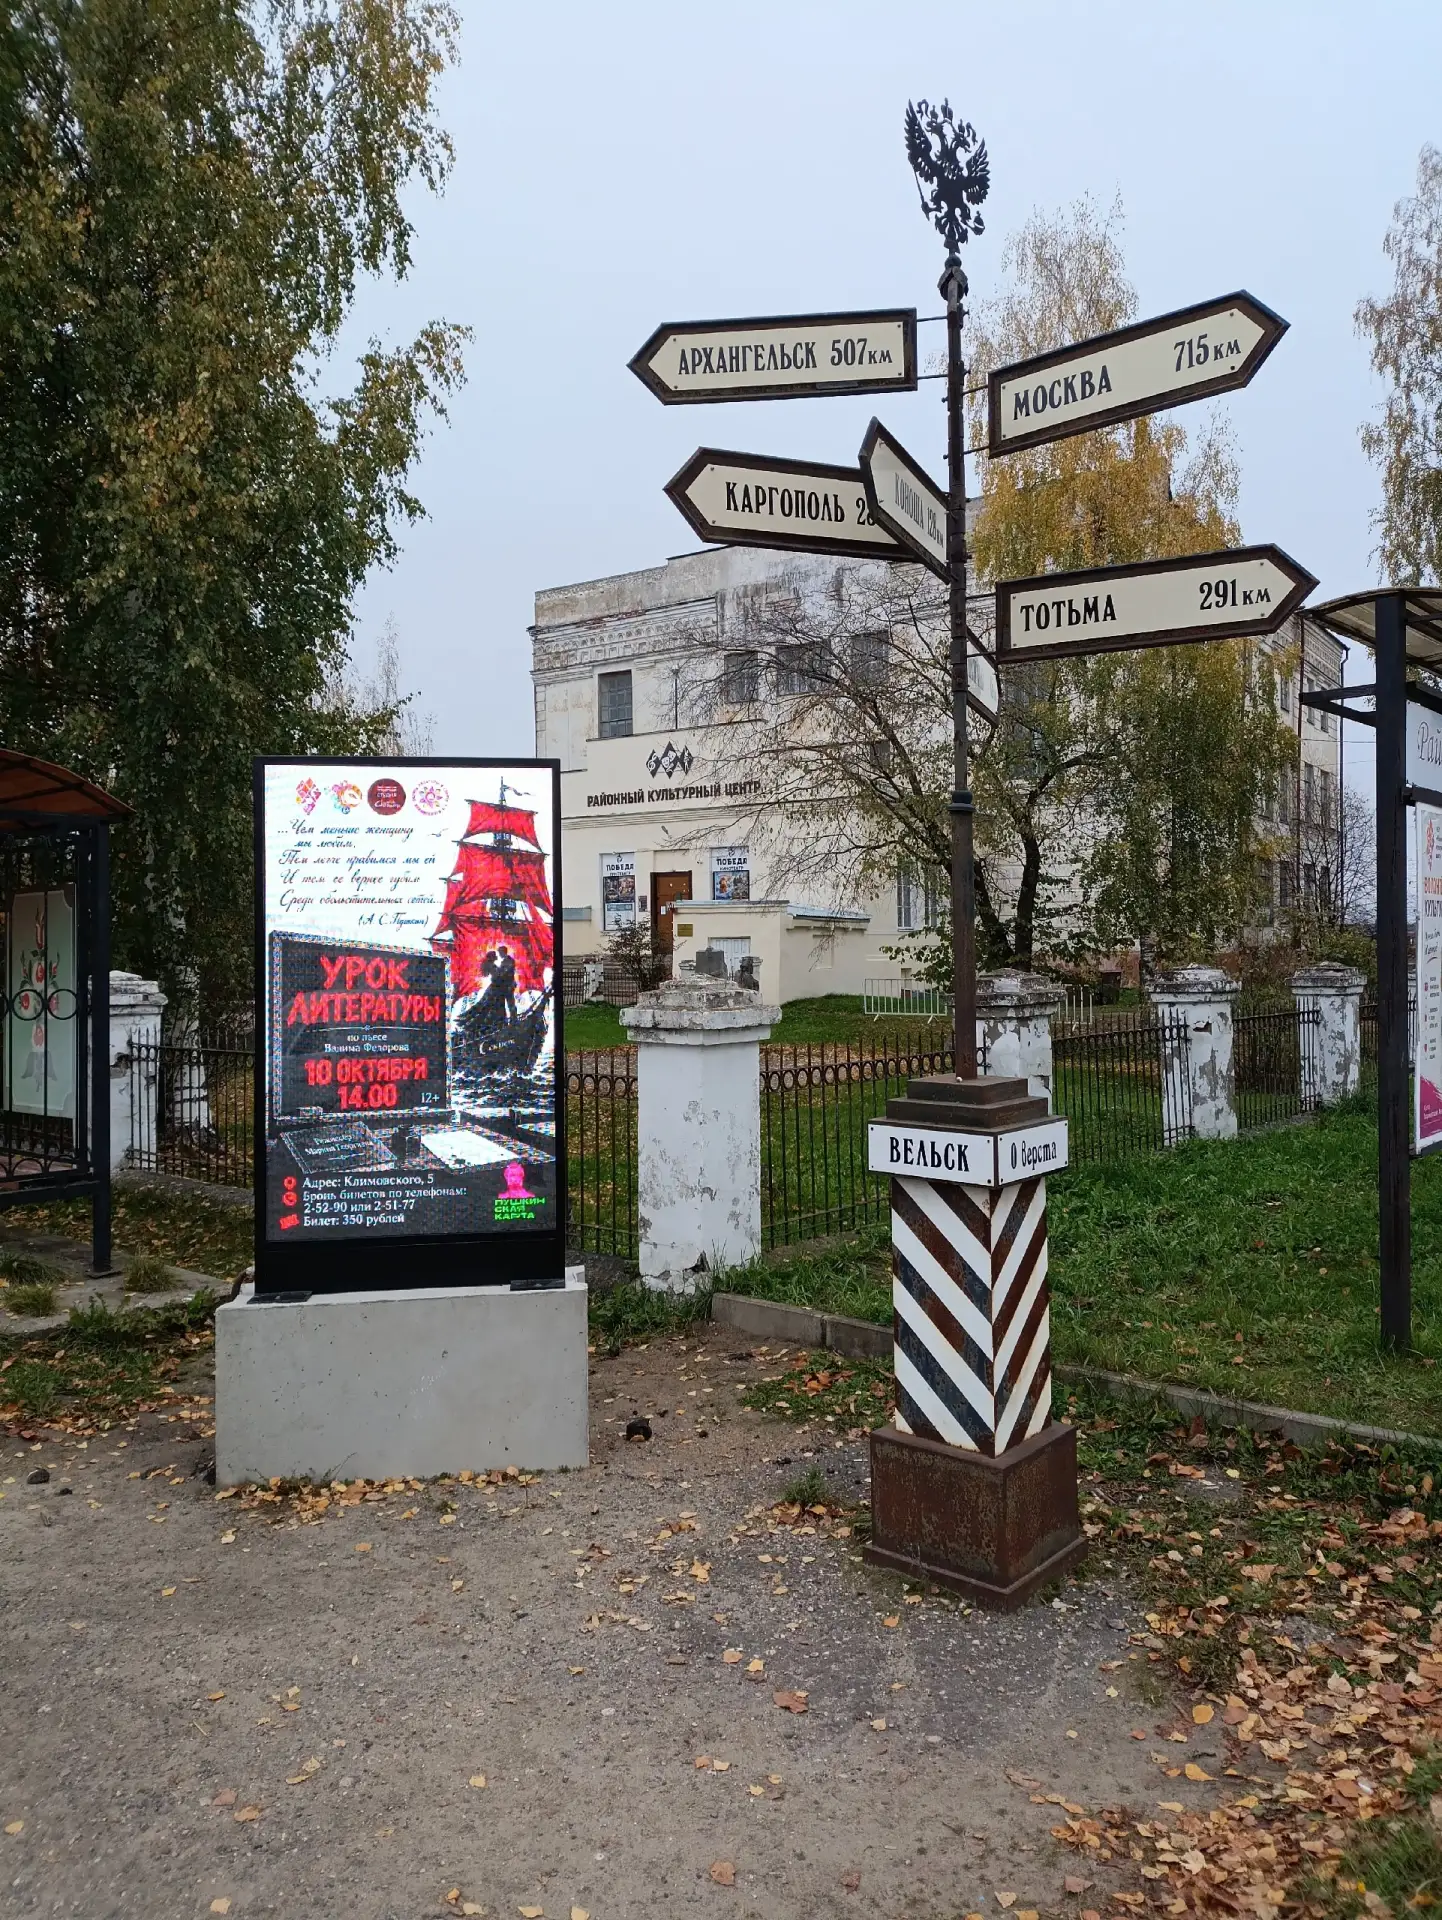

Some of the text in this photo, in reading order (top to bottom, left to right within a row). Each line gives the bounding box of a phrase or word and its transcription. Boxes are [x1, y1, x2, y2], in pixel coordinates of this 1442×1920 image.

[678, 341, 817, 375] АРХАНГЕЛЬСК
[1013, 364, 1112, 420] МОСКВА
[725, 481, 845, 523] КАРГОПОЛЬ
[894, 472, 924, 529] КОНОША
[1020, 594, 1117, 632] ТОТЬМА
[587, 780, 761, 807] РАЙОННЫЙ КУЛЬТУРНЫЙ ЦЕНТР
[365, 826, 413, 843] женщину
[294, 840, 312, 848] мы
[278, 849, 308, 864] Тем
[346, 849, 396, 871] нравимся
[423, 853, 436, 864] ей
[606, 863, 634, 872] ПОБЕДА
[716, 857, 748, 866] ПОБЕДА
[280, 868, 300, 884] И
[320, 955, 410, 990] УРОК
[287, 990, 441, 1027] ЛИТЕРАТУРЫ
[347, 1033, 387, 1042] по пьесе
[304, 1057, 429, 1086] 10 ОКТЯБРЯ
[337, 1083, 398, 1110] 14.00
[421, 1092, 440, 1103] 12+
[889, 1136, 970, 1172] ВЕЛЬСК
[1021, 1140, 1057, 1170] верста
[302, 1173, 434, 1191] Адрес: Климовского, 5
[302, 1186, 467, 1203] Бронь билетов по телефонам:
[494, 1197, 545, 1206] ПУШКИН
[303, 1198, 416, 1214] 2-52-90 или 2-51-77
[494, 1205, 525, 1213] СКАЯ
[303, 1212, 405, 1227] Билет: 350 рублей
[494, 1212, 535, 1220] КАРТА
